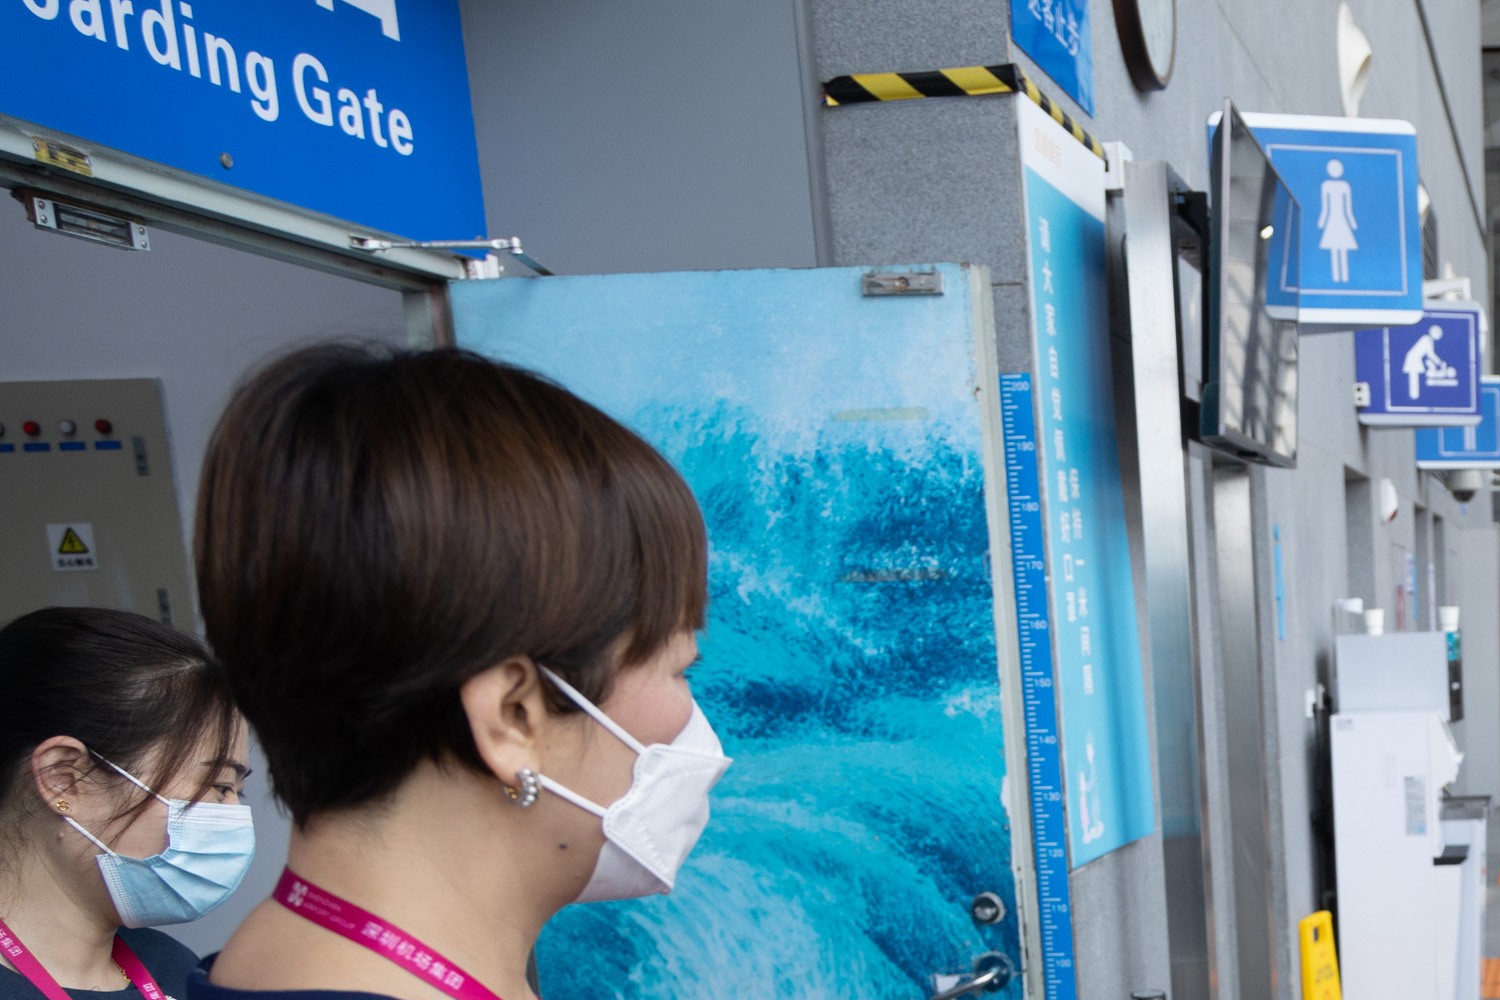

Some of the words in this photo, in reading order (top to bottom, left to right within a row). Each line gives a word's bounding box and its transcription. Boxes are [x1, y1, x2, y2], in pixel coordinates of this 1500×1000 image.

[292, 52, 414, 157] Gate
[361, 921, 465, 990] 深圳机场集团
